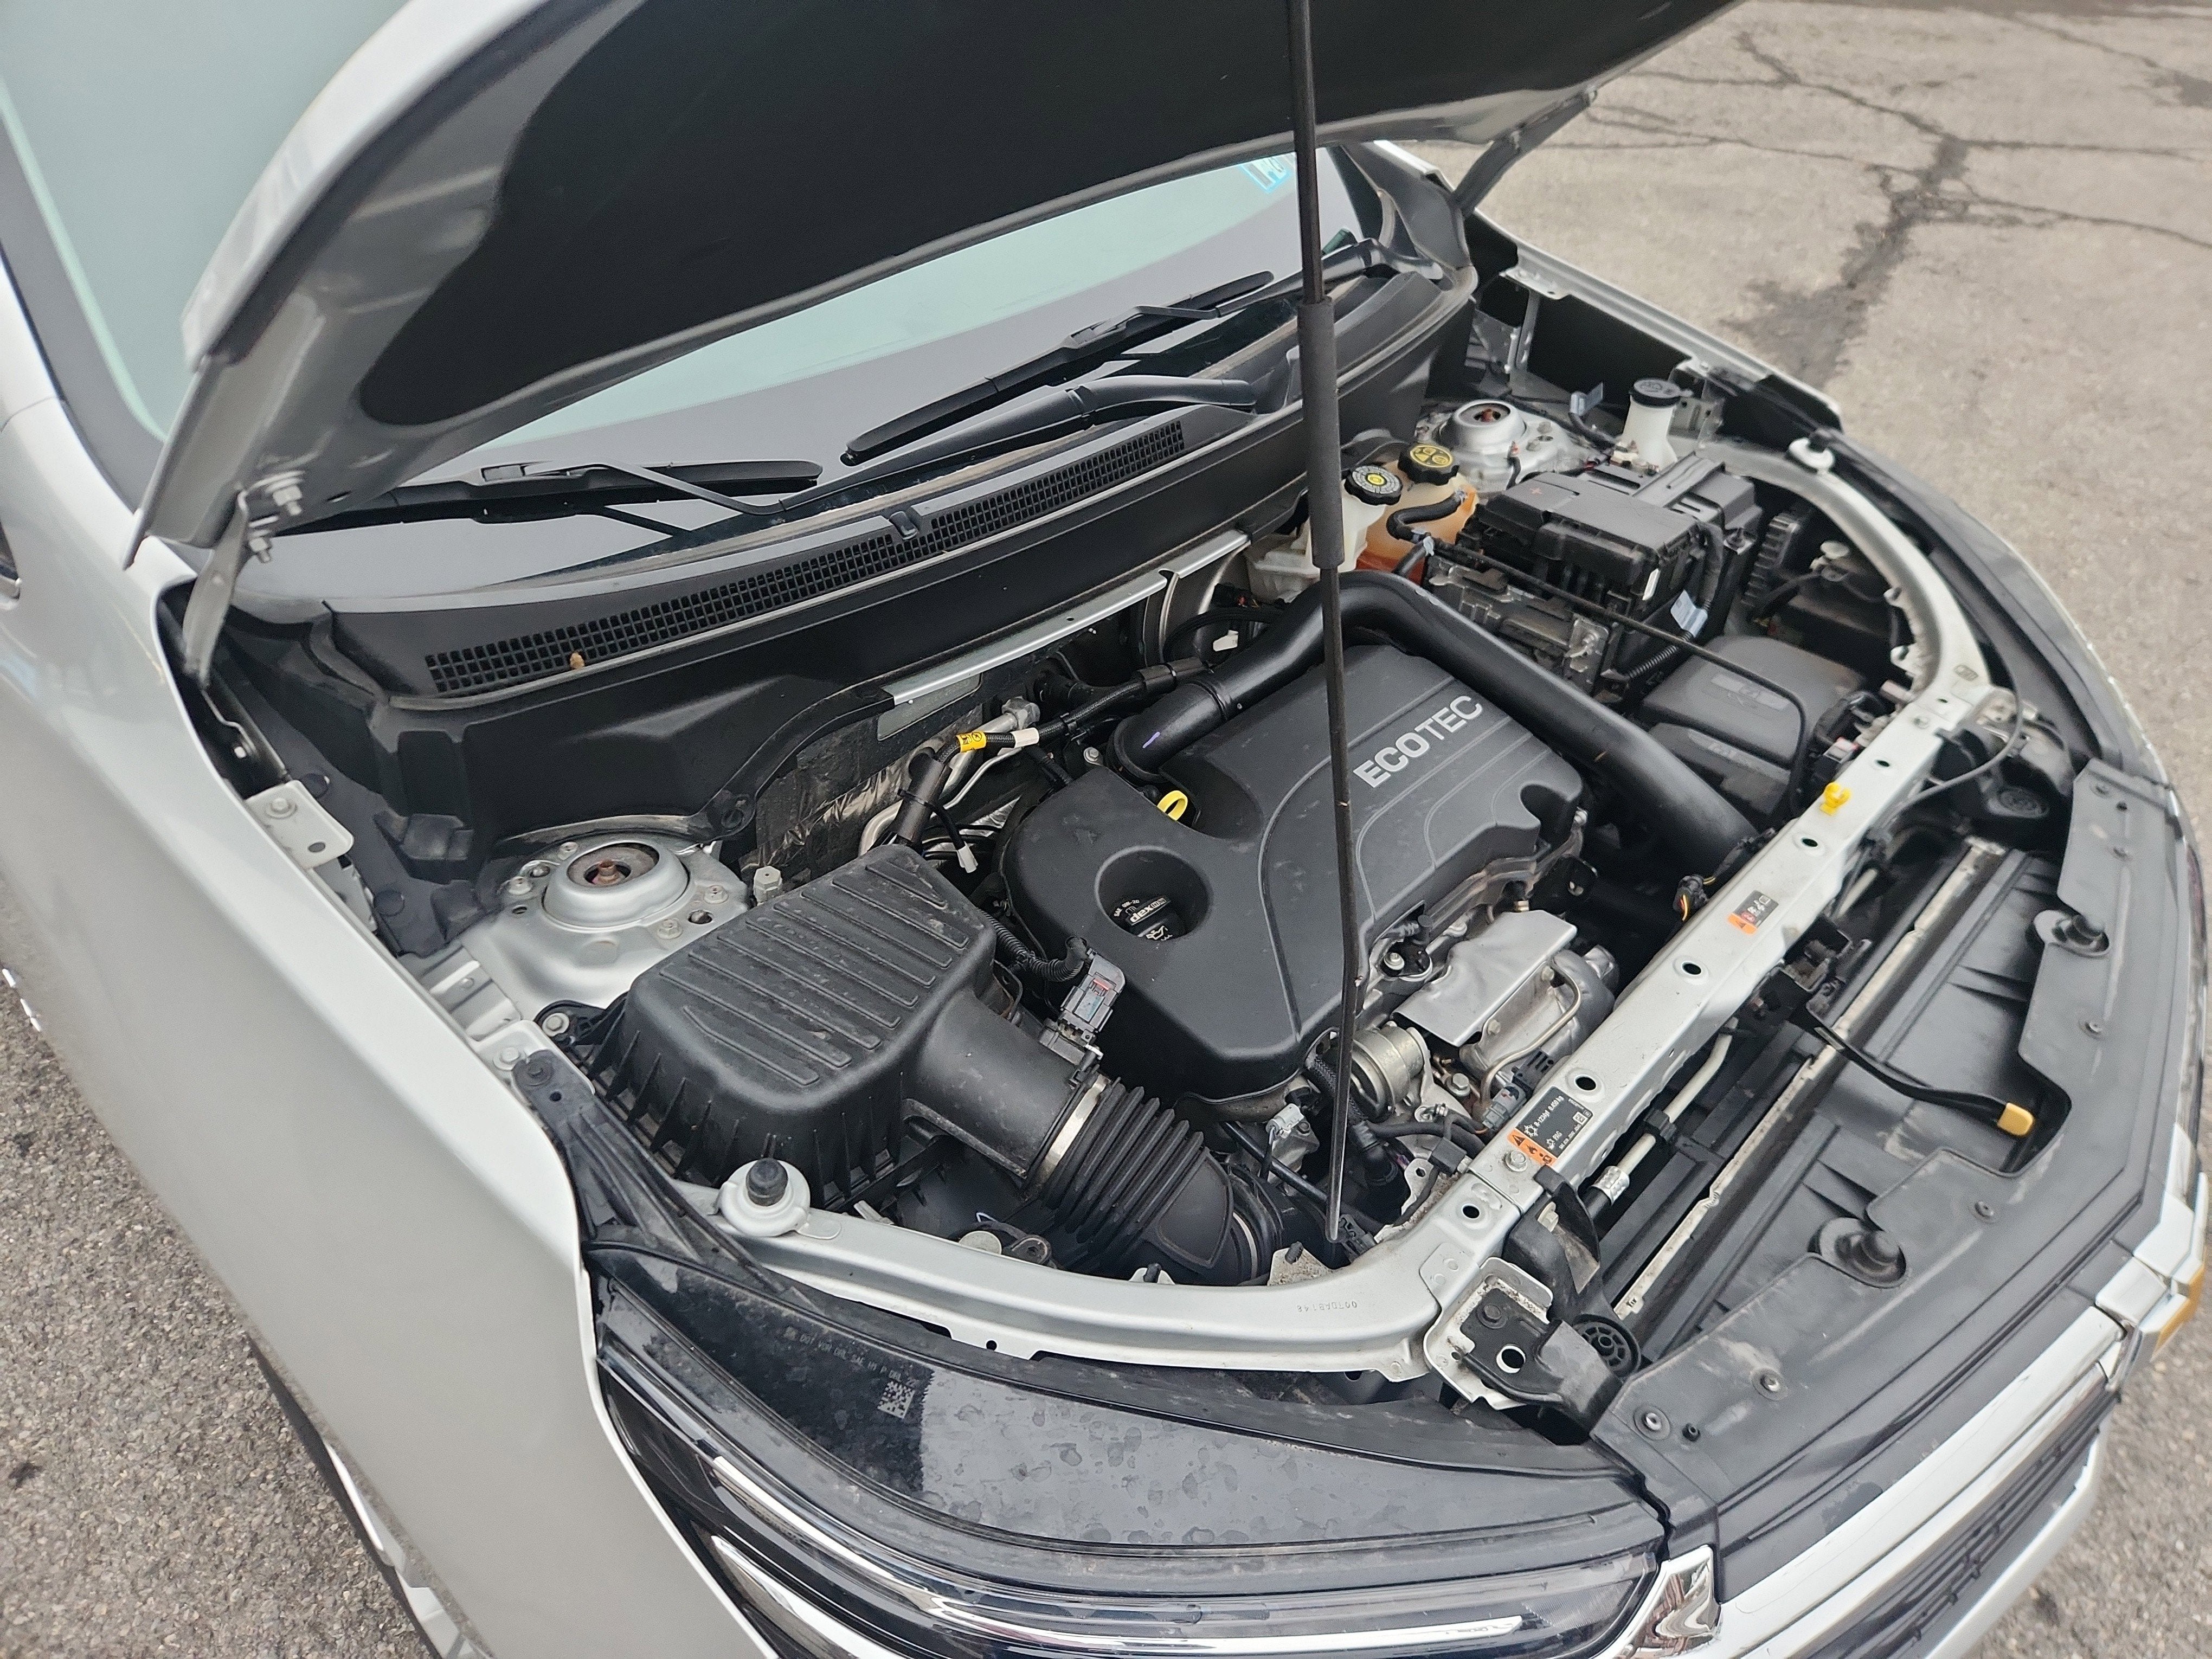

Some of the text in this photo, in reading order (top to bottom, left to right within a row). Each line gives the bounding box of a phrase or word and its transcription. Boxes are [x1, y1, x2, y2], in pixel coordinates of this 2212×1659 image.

[1353, 695, 1483, 788] ECOTEC
[1114, 908, 1123, 917] SAE
[1130, 897, 1167, 923] dexos
[1552, 1130, 1562, 1141] PAG
